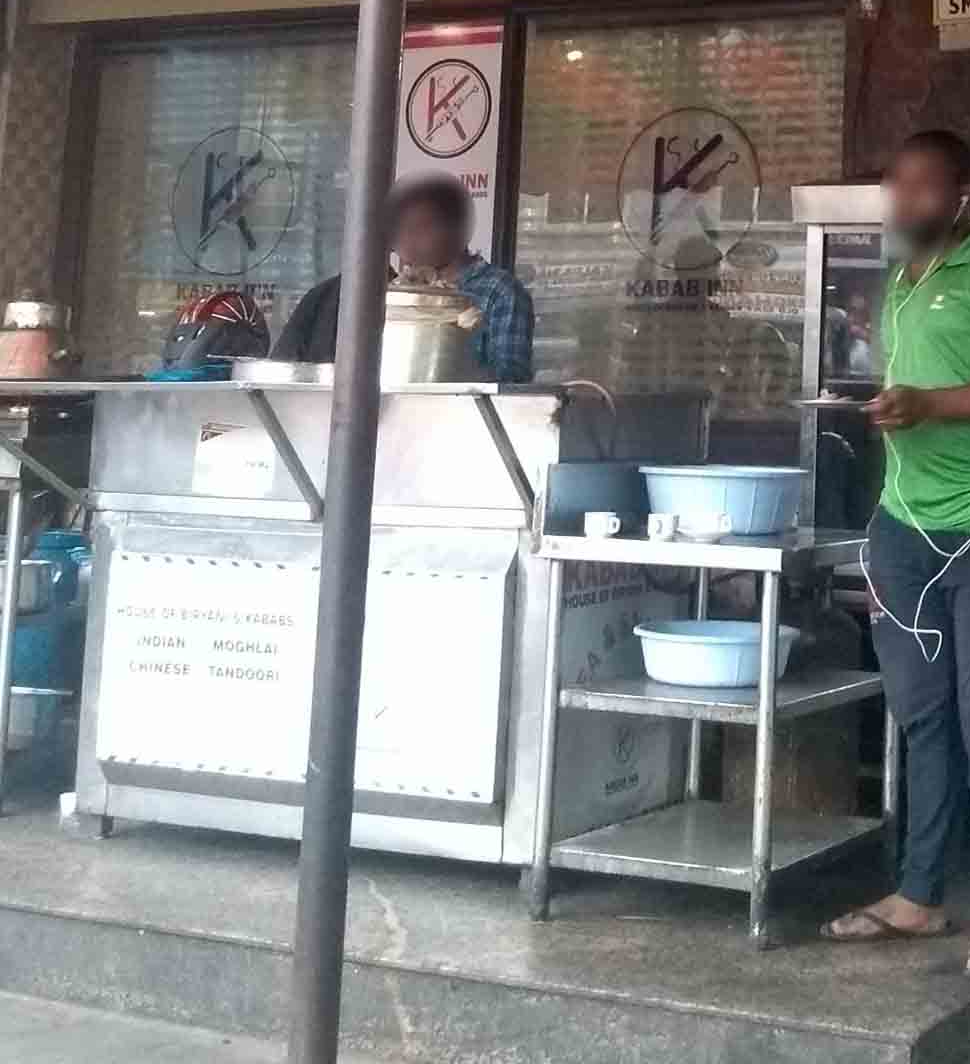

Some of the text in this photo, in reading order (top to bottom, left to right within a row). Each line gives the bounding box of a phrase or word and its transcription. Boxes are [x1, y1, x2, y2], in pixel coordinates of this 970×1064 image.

[625, 280, 700, 298] KABAB
[136, 636, 279, 655] INDIAN MOGHLAI
[128, 661, 280, 681] CHINESE TANDOORI
